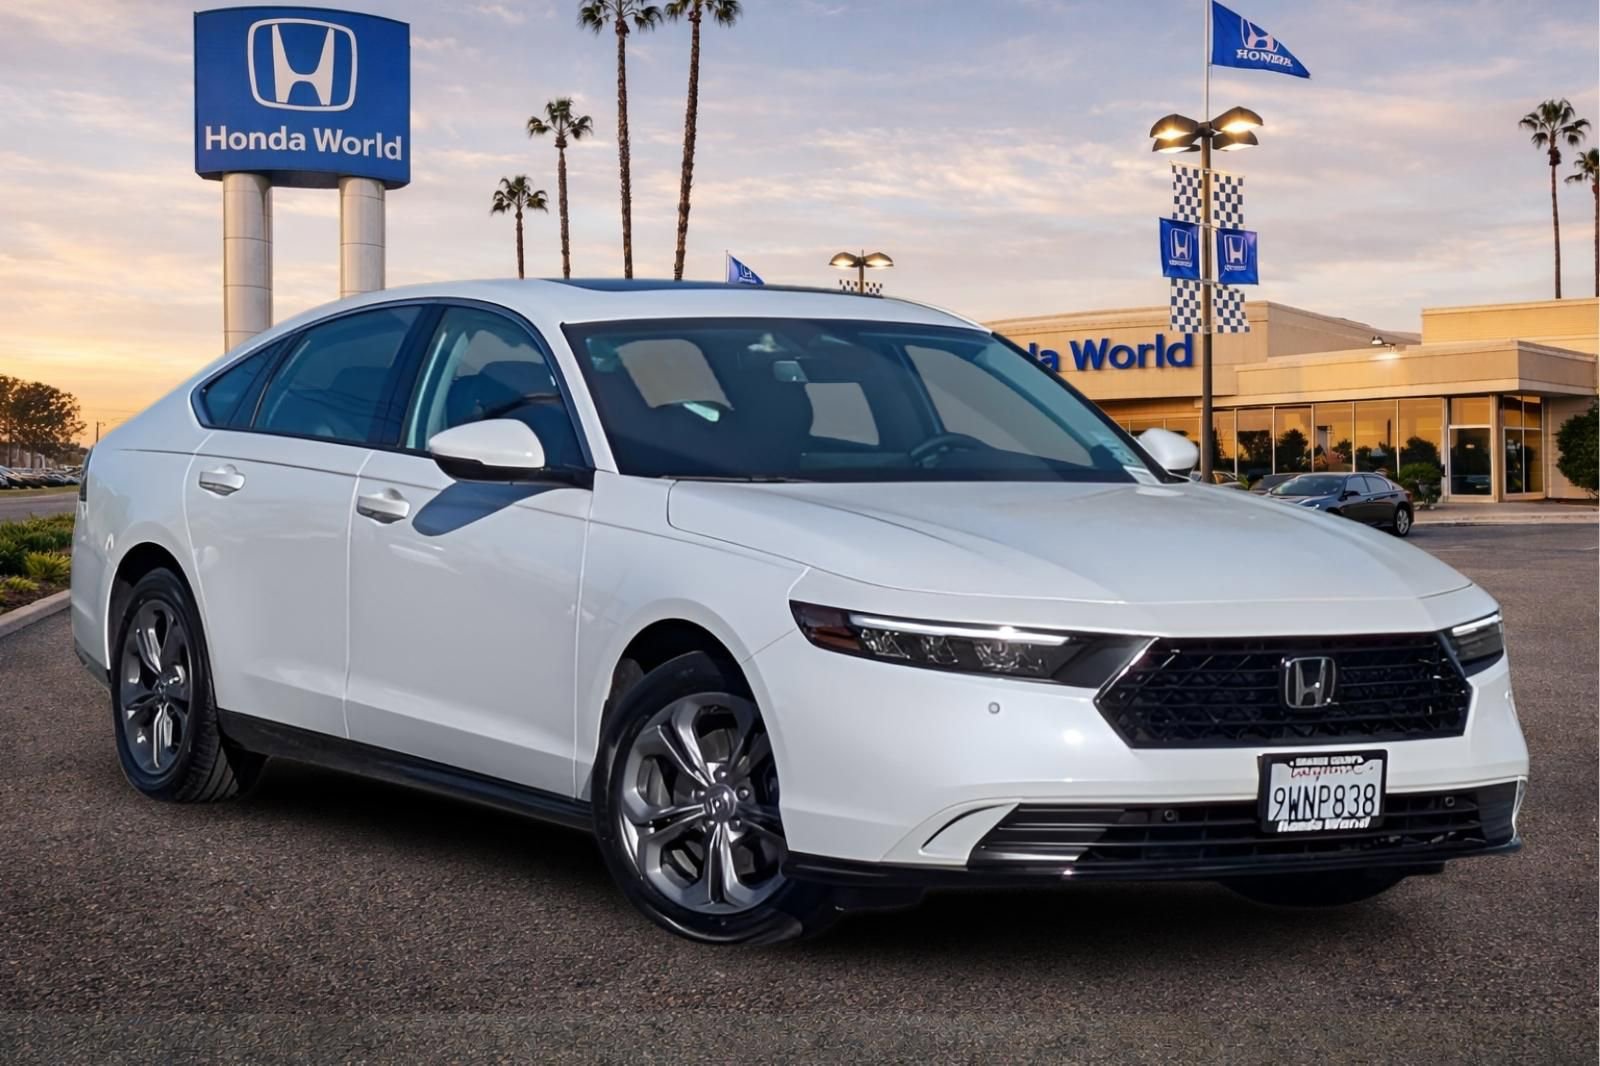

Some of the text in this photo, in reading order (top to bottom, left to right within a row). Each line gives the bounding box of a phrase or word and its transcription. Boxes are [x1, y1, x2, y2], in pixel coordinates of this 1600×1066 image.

[205, 125, 402, 160] Honda World
[1069, 333, 1194, 371] World
[1273, 783, 1376, 821] 9WNP838
